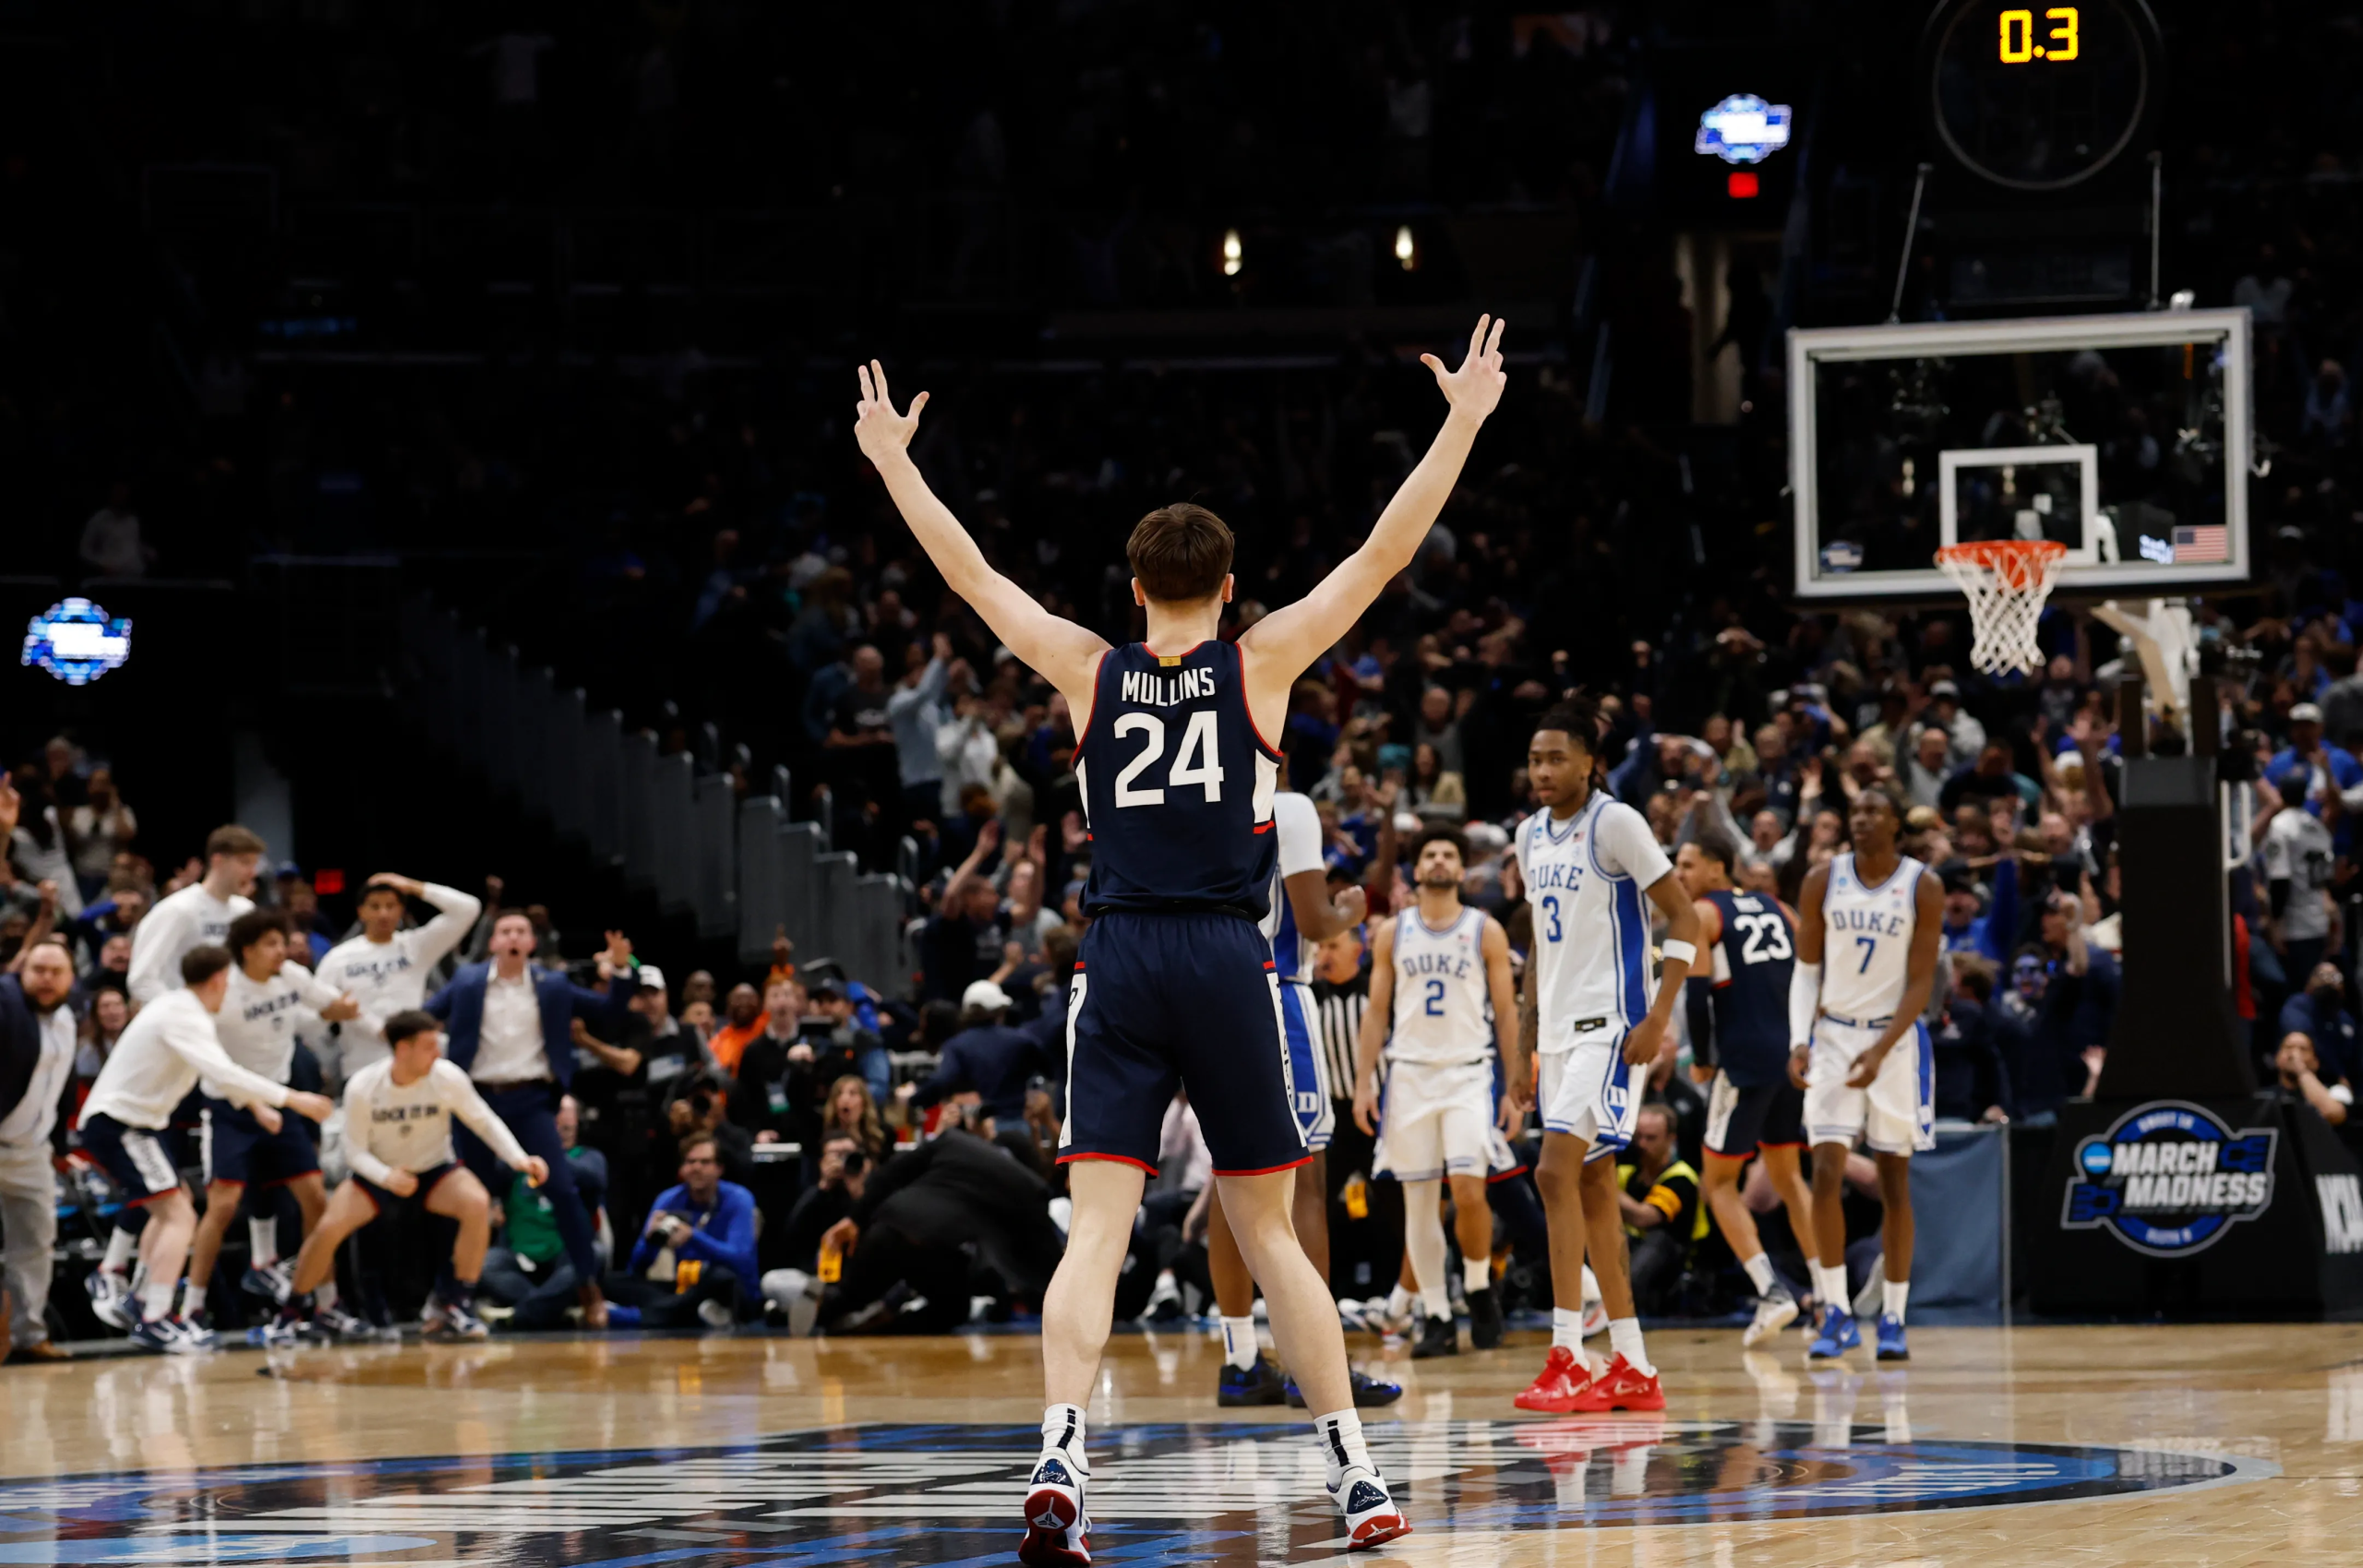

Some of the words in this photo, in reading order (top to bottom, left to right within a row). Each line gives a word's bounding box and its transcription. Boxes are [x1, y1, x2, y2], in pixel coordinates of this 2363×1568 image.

[1999, 7, 2079, 63] 0.3
[1122, 666, 1217, 707] MULLINS
[1113, 710, 1225, 808] 24
[1528, 862, 1584, 892] DUKE
[1542, 895, 1562, 943] 3
[1831, 909, 1905, 938] DUKE
[1733, 913, 1793, 964] 23
[1855, 936, 1877, 975] 7
[1402, 953, 1471, 979] DUKE
[1425, 979, 1445, 1016] 2
[1297, 1091, 1318, 1113] D
[2111, 1141, 2220, 1176] MARCH
[2124, 1172, 2268, 1207] MADNESS
